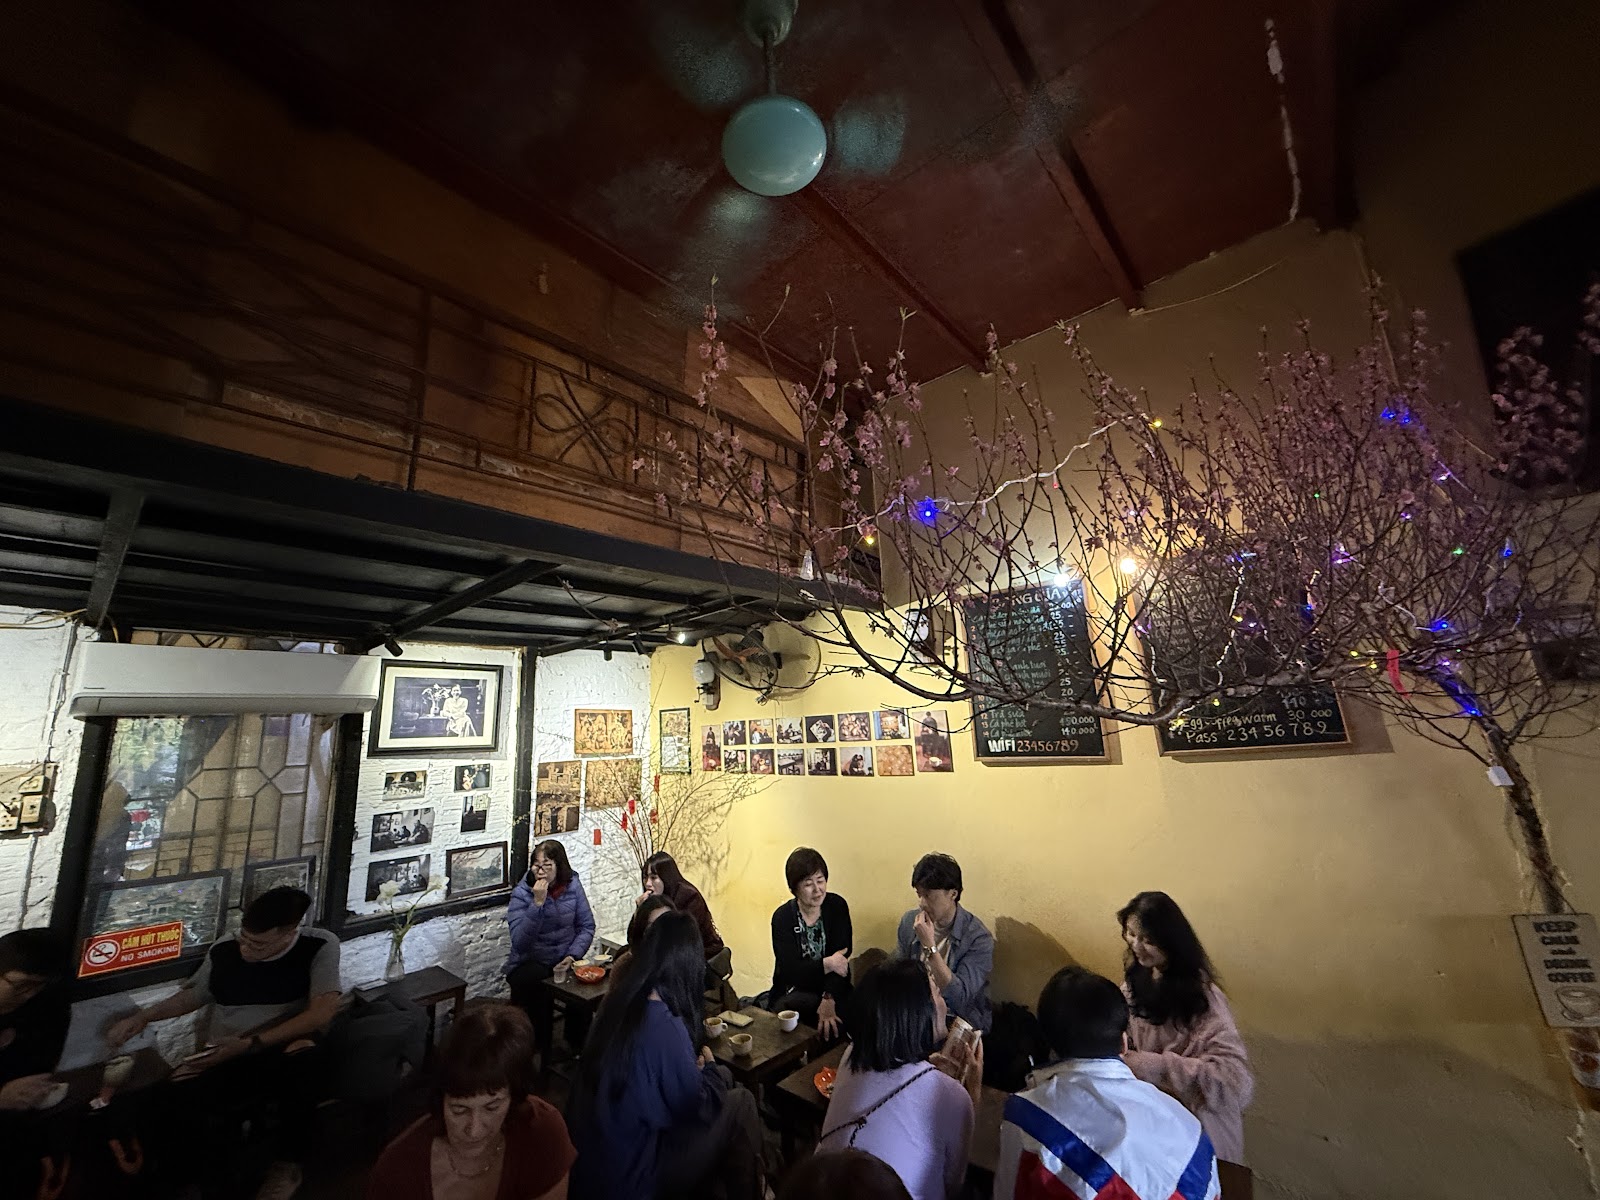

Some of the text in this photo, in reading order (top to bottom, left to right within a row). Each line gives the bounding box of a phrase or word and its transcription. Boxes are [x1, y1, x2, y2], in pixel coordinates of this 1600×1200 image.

[1050, 611, 1062, 620] 25
[1060, 678, 1072, 687] 25
[1061, 687, 1074, 697] 20
[1186, 731, 1218, 743] Pass
[1017, 739, 1080, 753] 23456789
[1532, 920, 1580, 933] KEEP
[120, 944, 178, 962] NO SMOKING
[1547, 971, 1597, 983] COFFEE
